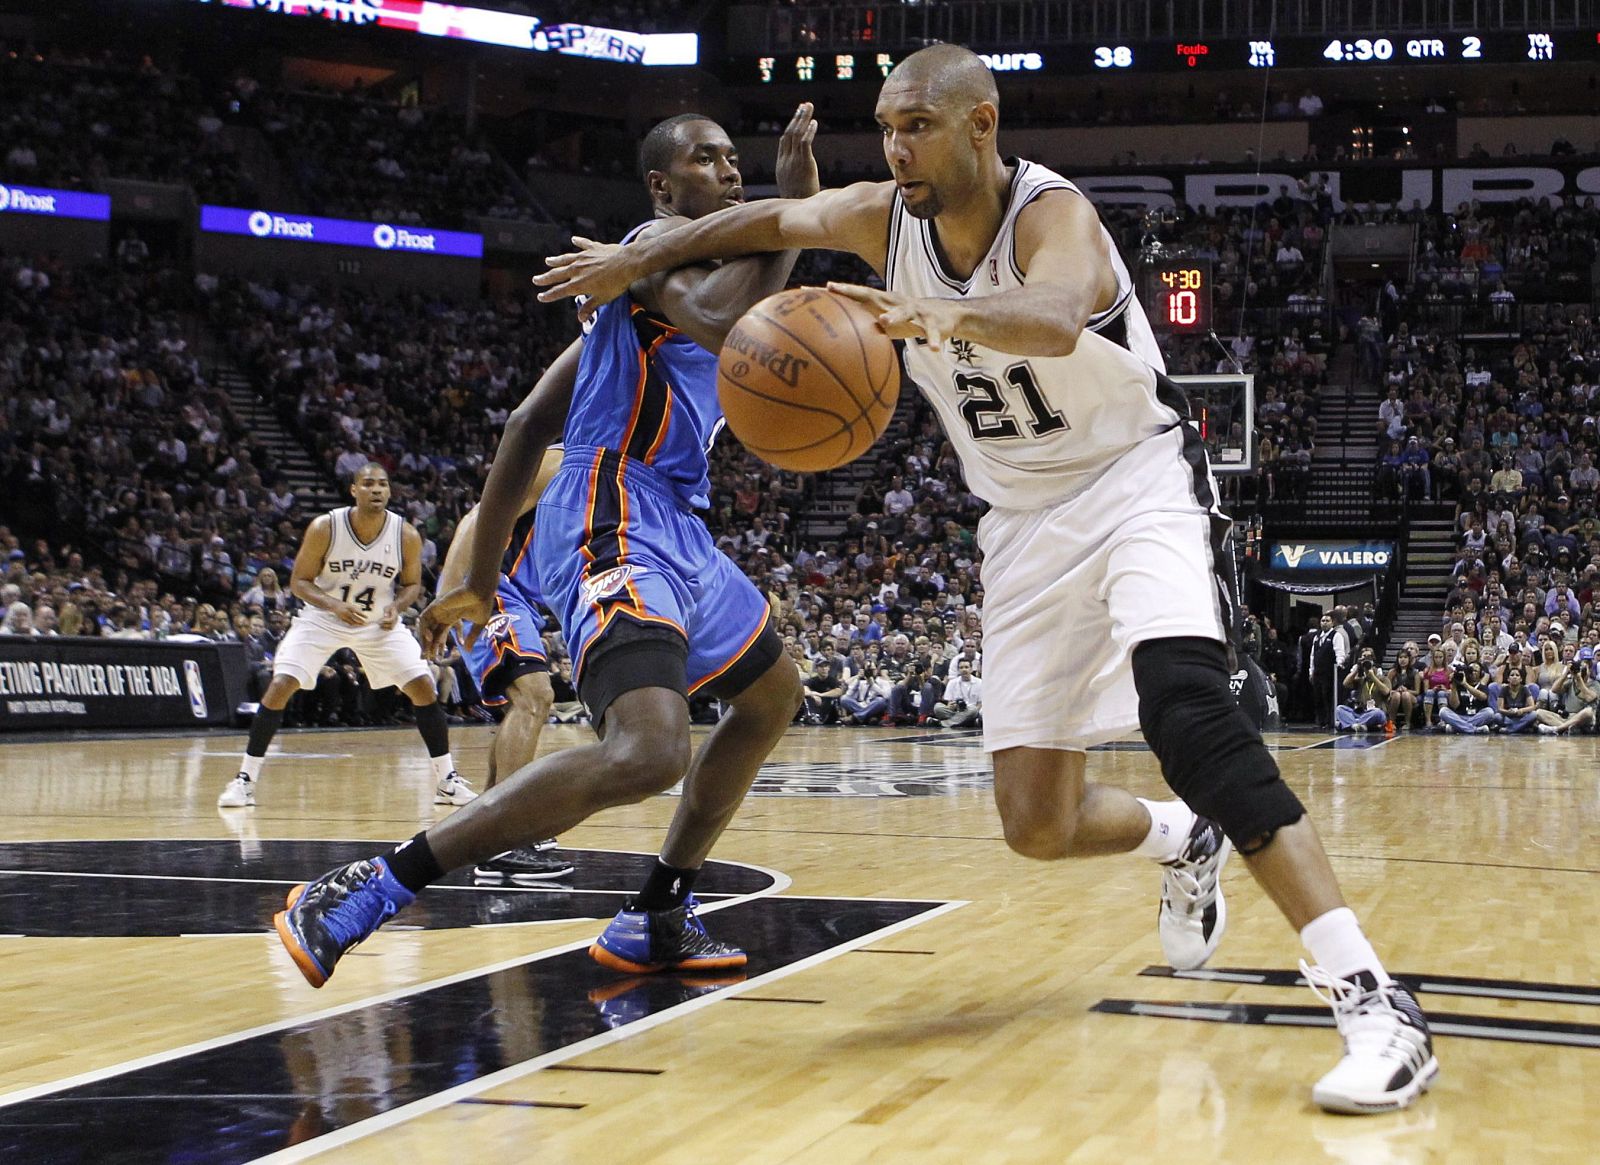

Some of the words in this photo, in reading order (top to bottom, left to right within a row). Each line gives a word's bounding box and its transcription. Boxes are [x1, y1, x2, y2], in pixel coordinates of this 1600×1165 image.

[1177, 44, 1208, 55] Fouls
[1249, 41, 1274, 54] TOL
[1323, 39, 1393, 61] 4:30
[1406, 39, 1444, 58] QTR
[1461, 36, 1482, 58] 2
[1527, 34, 1553, 47] TOL
[759, 57, 775, 69] ST
[796, 56, 814, 68] AS
[1094, 46, 1133, 68] 38
[1187, 55, 1196, 67] 0
[10, 188, 56, 213] Frost
[1070, 168, 1600, 214] SPUR
[273, 216, 314, 238] Frost
[396, 229, 435, 250] Frost
[1162, 269, 1201, 289] 4:30
[1169, 290, 1196, 325] 10
[953, 359, 1072, 441] 21
[1319, 551, 1388, 565] VALERO
[328, 559, 396, 580] SPURS
[341, 585, 376, 612] 14
[42, 661, 109, 695] PARTNER
[106, 664, 126, 696] OF
[123, 664, 153, 696] THE
[150, 665, 183, 697] NBA
